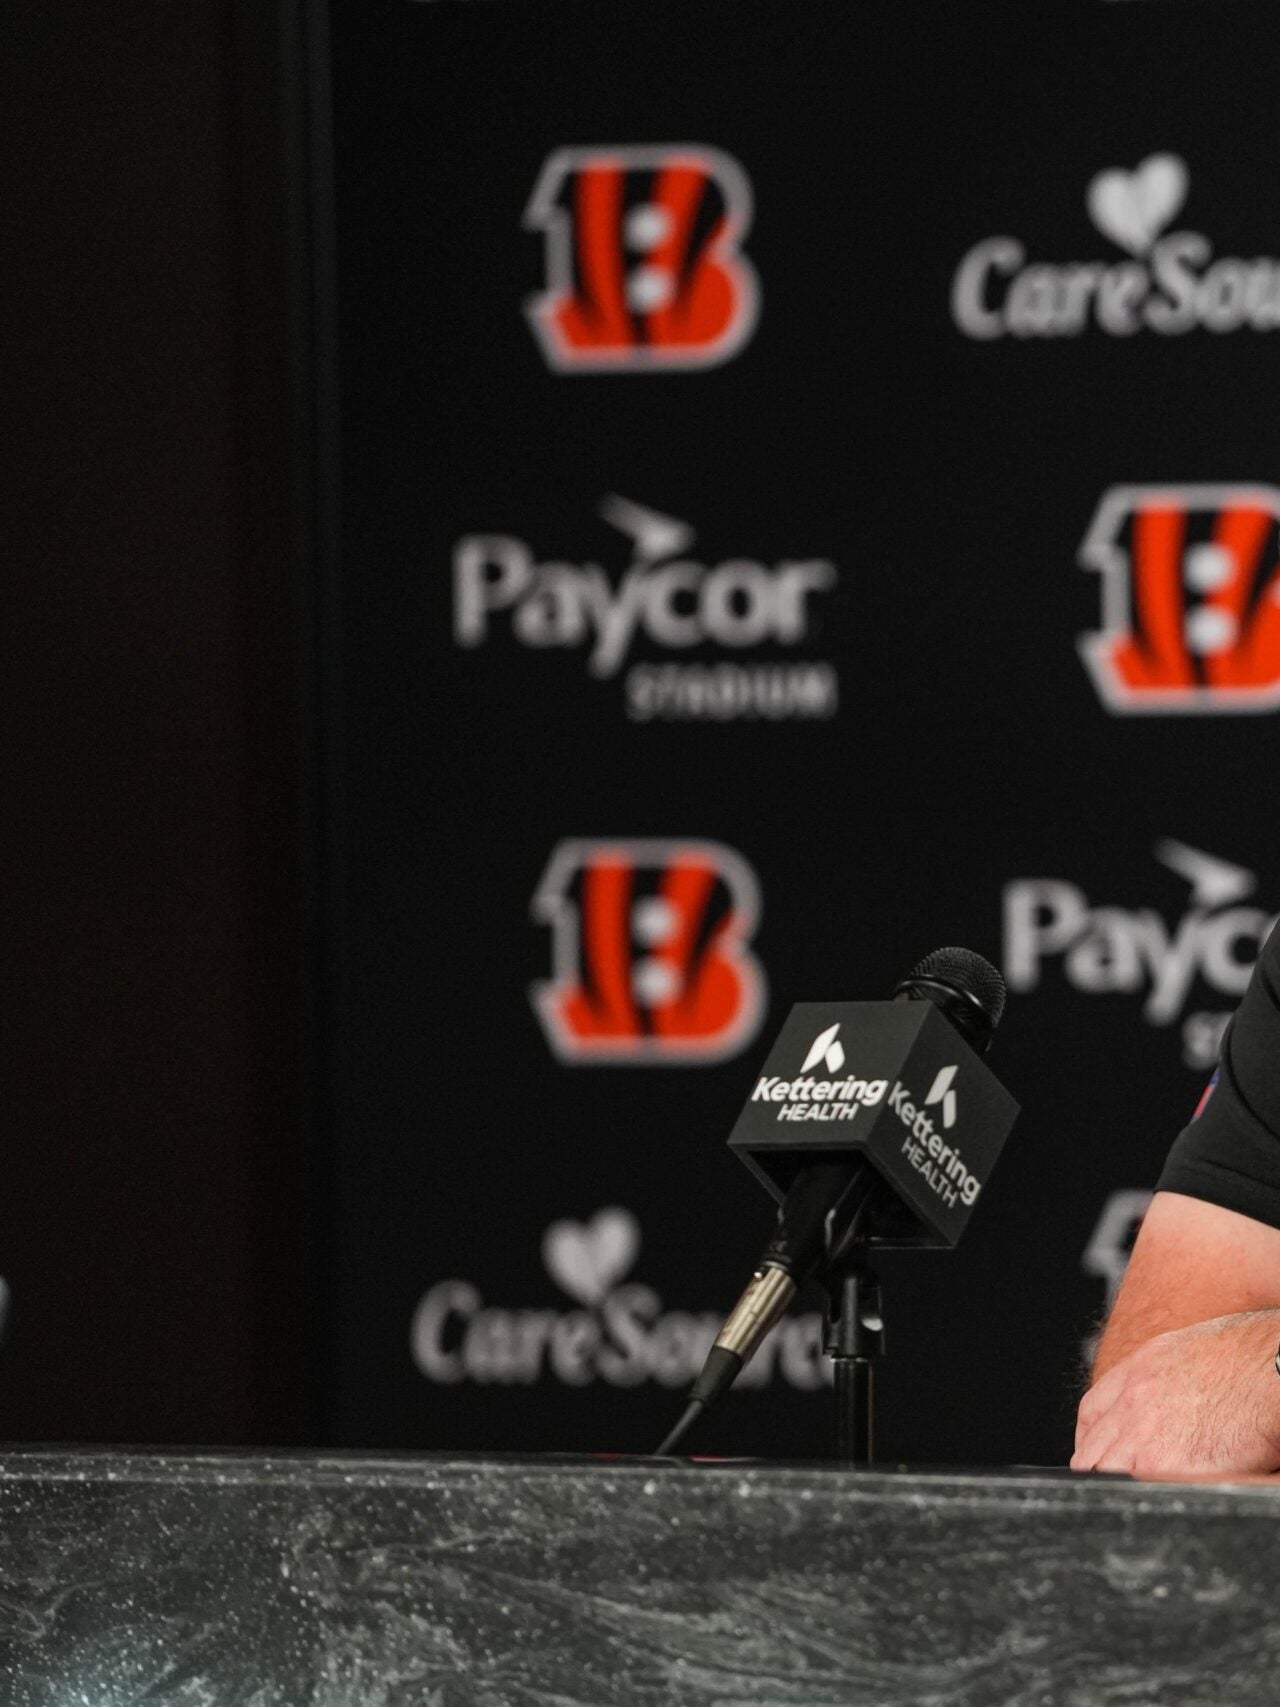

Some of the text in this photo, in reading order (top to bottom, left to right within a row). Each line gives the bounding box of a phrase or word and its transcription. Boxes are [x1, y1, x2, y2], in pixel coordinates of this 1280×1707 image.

[453, 532, 837, 678] Paycor
[1003, 877, 1280, 1026] Payc
[751, 1074, 889, 1106] Kettering
[776, 1102, 859, 1121] HEALTH
[887, 1081, 981, 1206] Kettering
[901, 1136, 958, 1208] HEALTH
